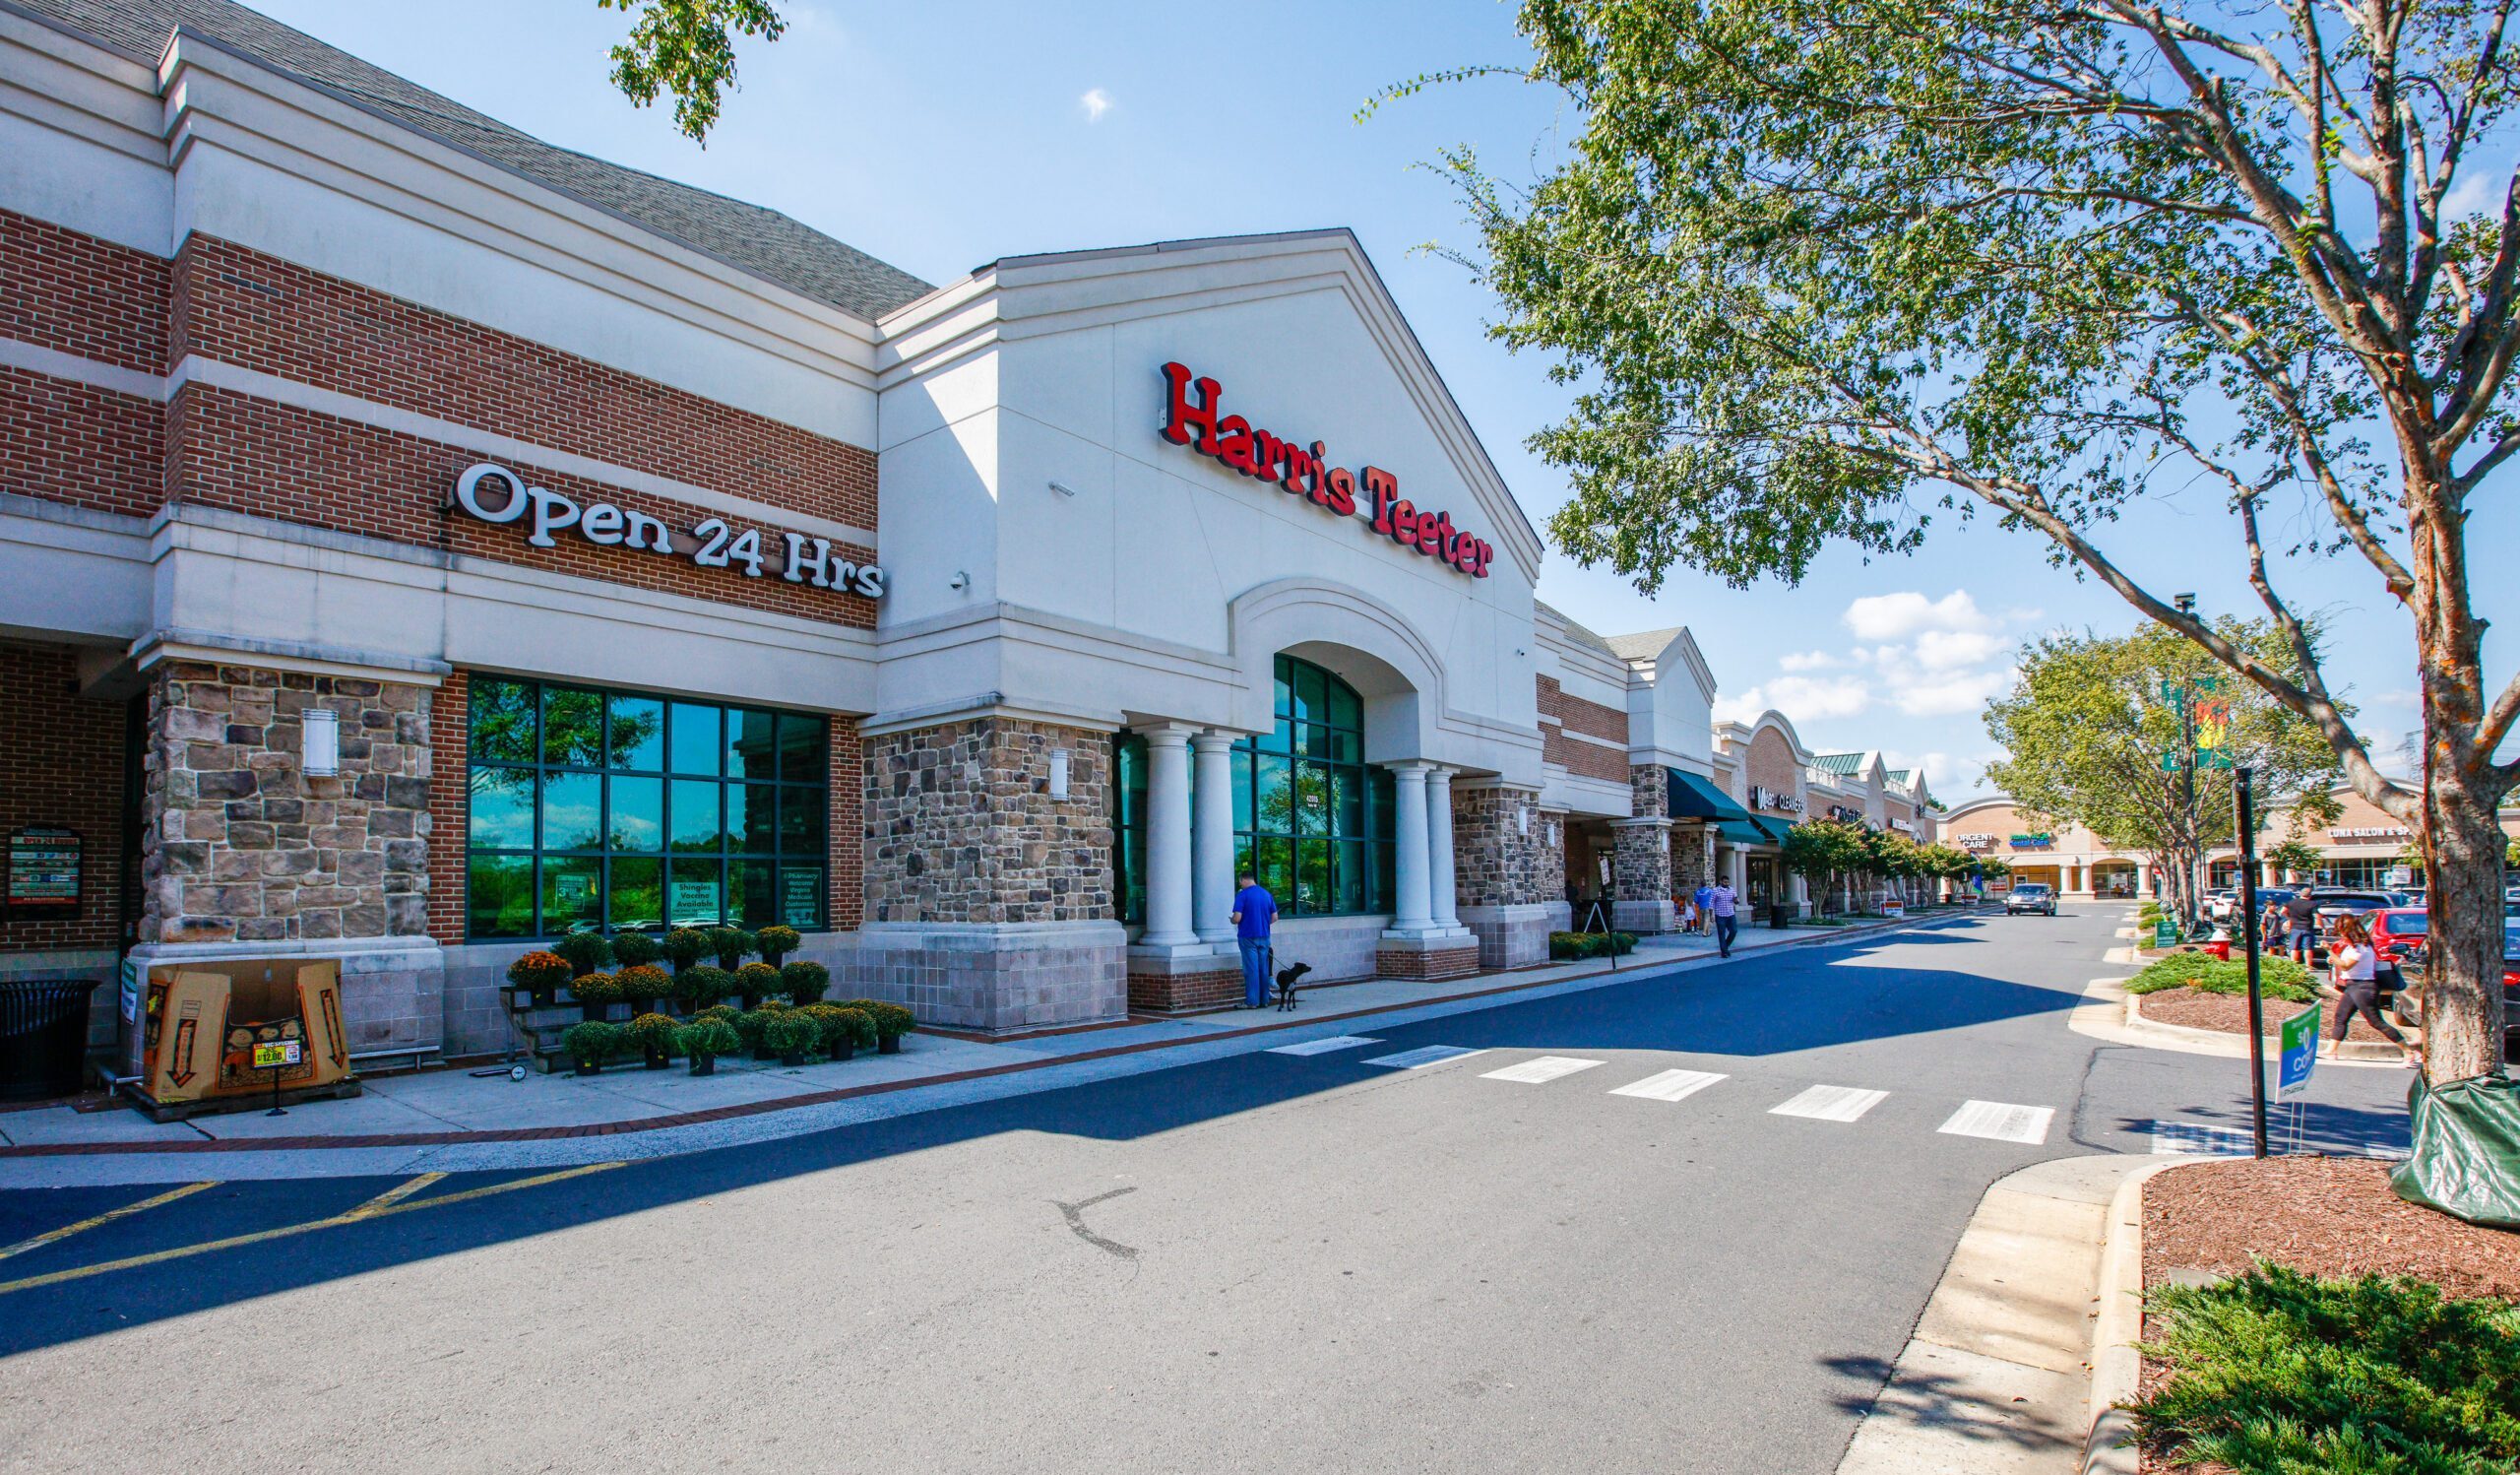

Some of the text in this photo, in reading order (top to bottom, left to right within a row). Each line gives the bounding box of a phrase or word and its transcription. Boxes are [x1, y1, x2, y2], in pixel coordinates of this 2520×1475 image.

[1159, 361, 1494, 579] Harris Teeter
[452, 463, 885, 599] Open 24 Hrs
[1779, 794, 1804, 813] CLEANERS
[2328, 828, 2353, 837] LUNA
[2354, 827, 2384, 836] SALON
[2397, 825, 2411, 836] SP
